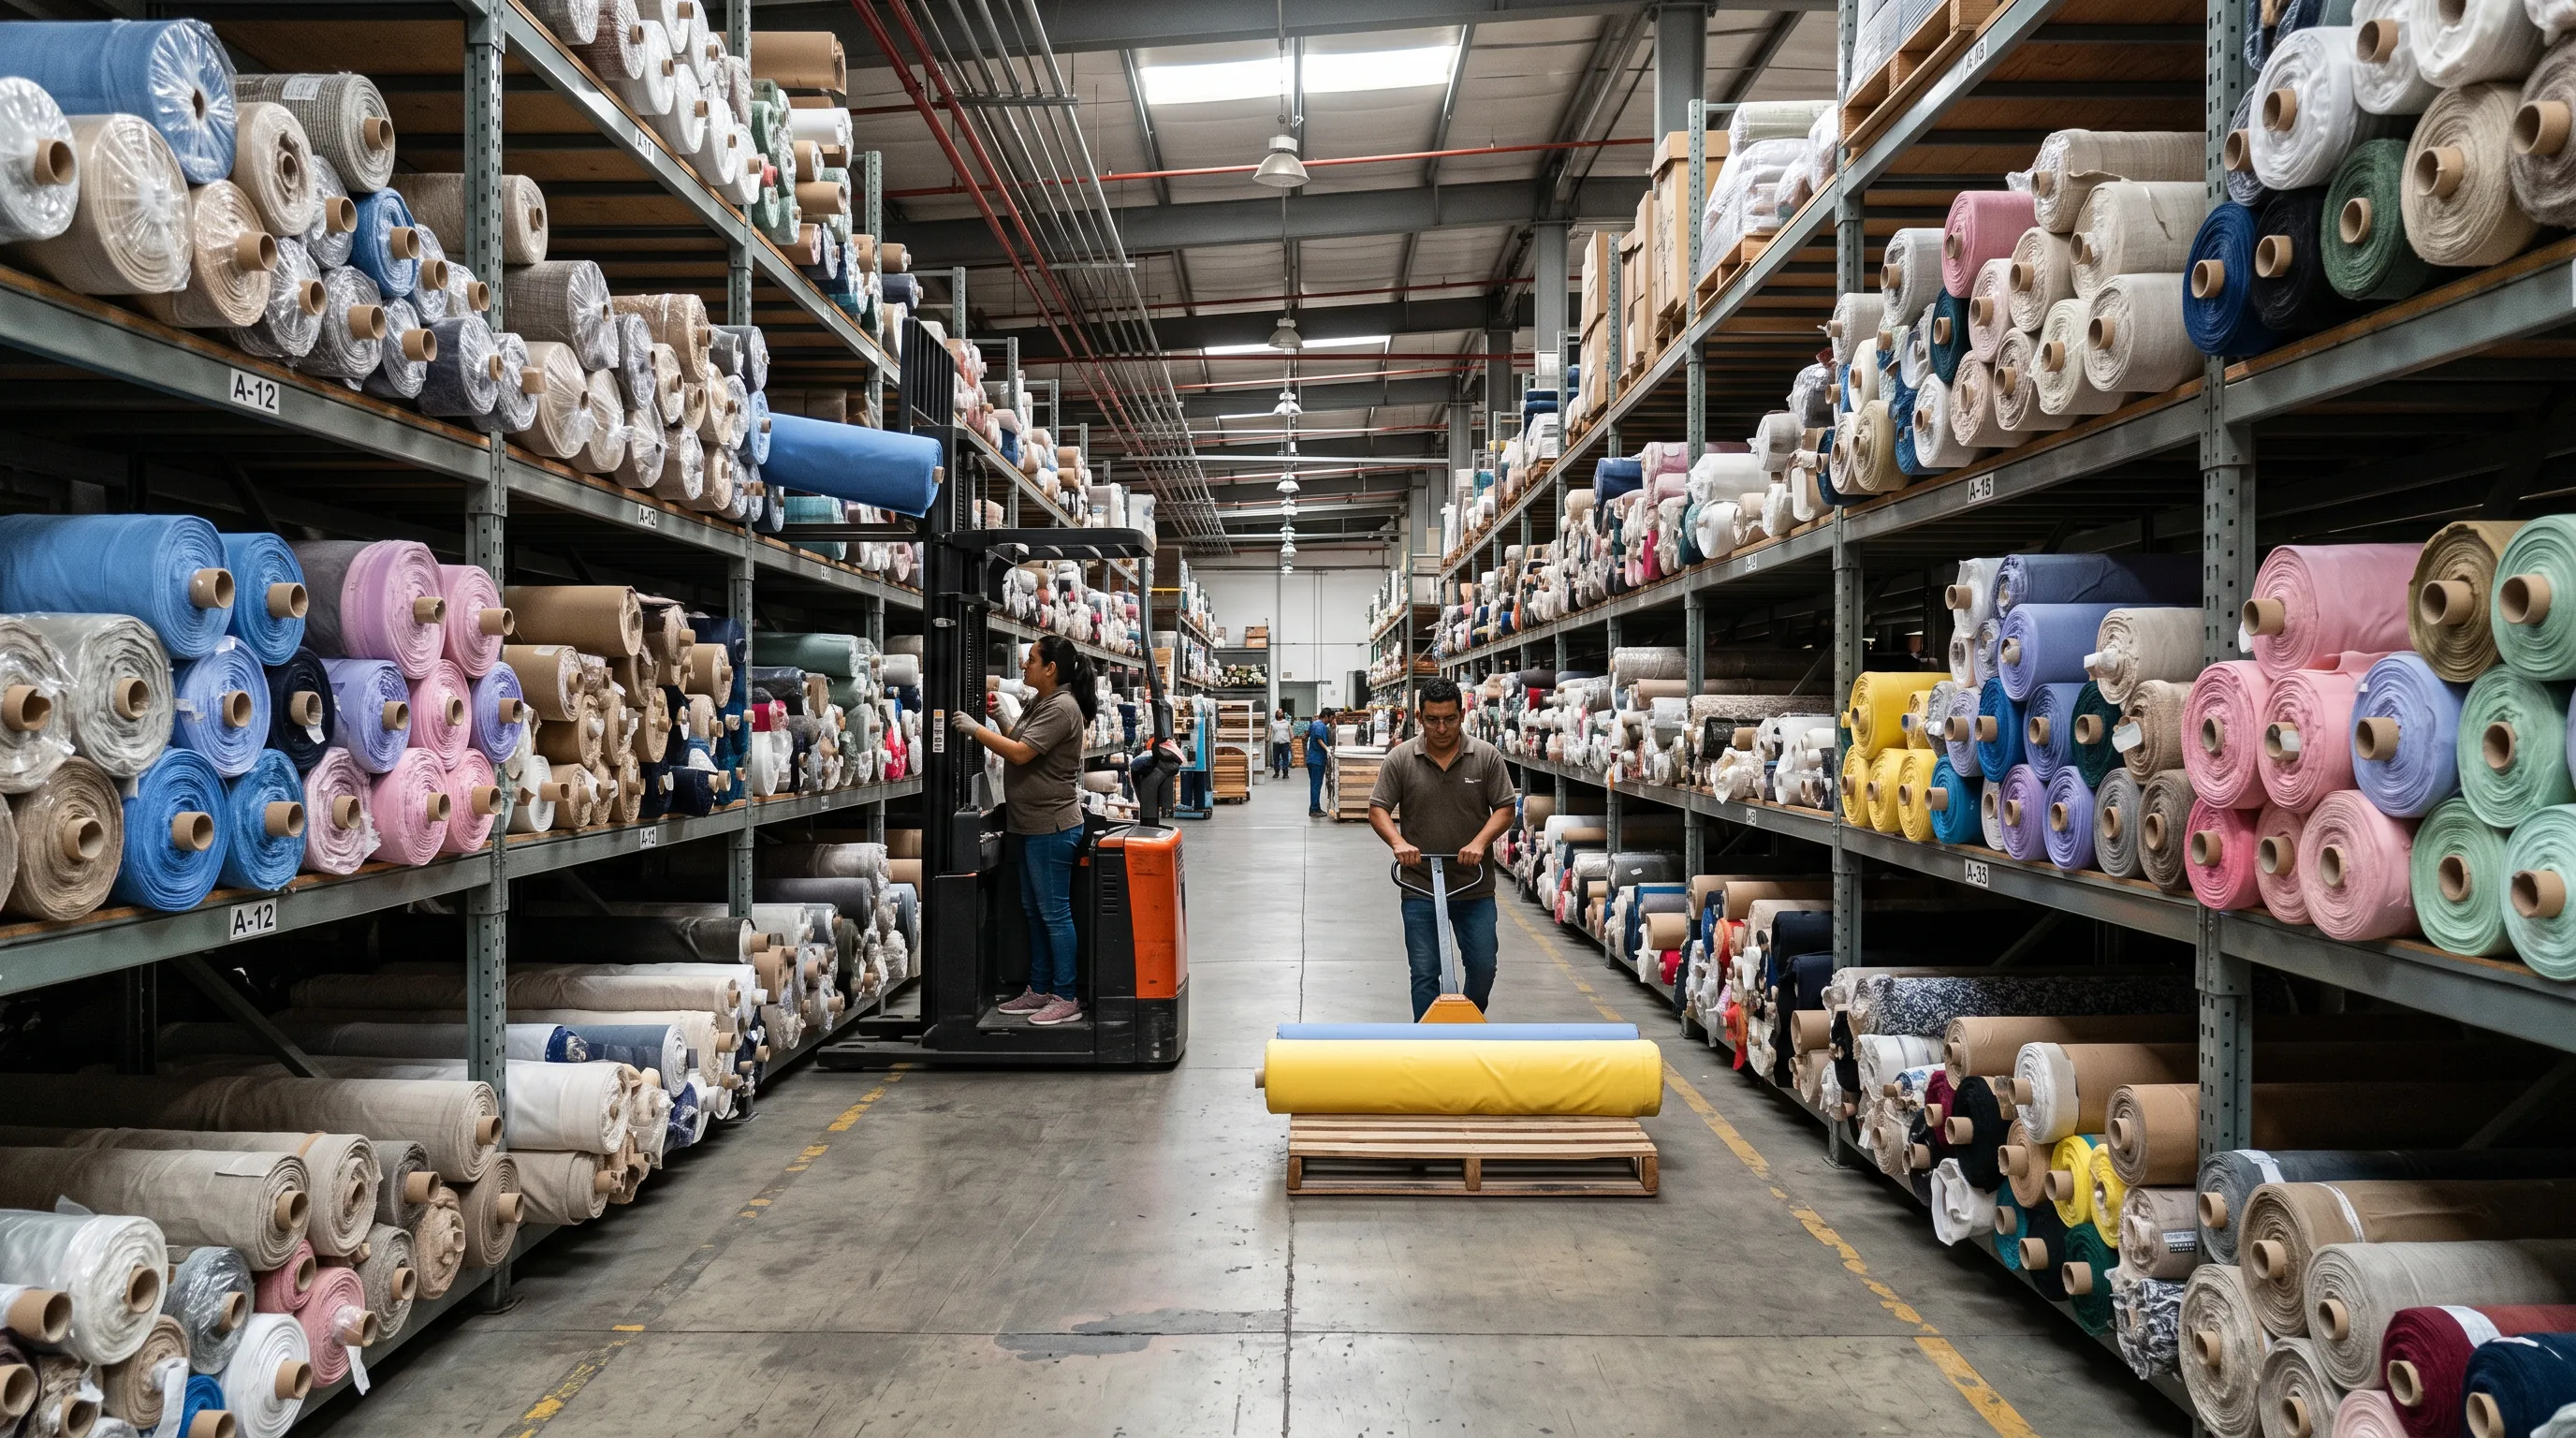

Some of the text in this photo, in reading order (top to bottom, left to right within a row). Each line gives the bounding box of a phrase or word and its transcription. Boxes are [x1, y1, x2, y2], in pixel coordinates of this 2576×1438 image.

[234, 374, 275, 409] A-12
[1969, 477, 1991, 501] A-15
[639, 508, 655, 526] A-12
[233, 903, 273, 935] A-12
